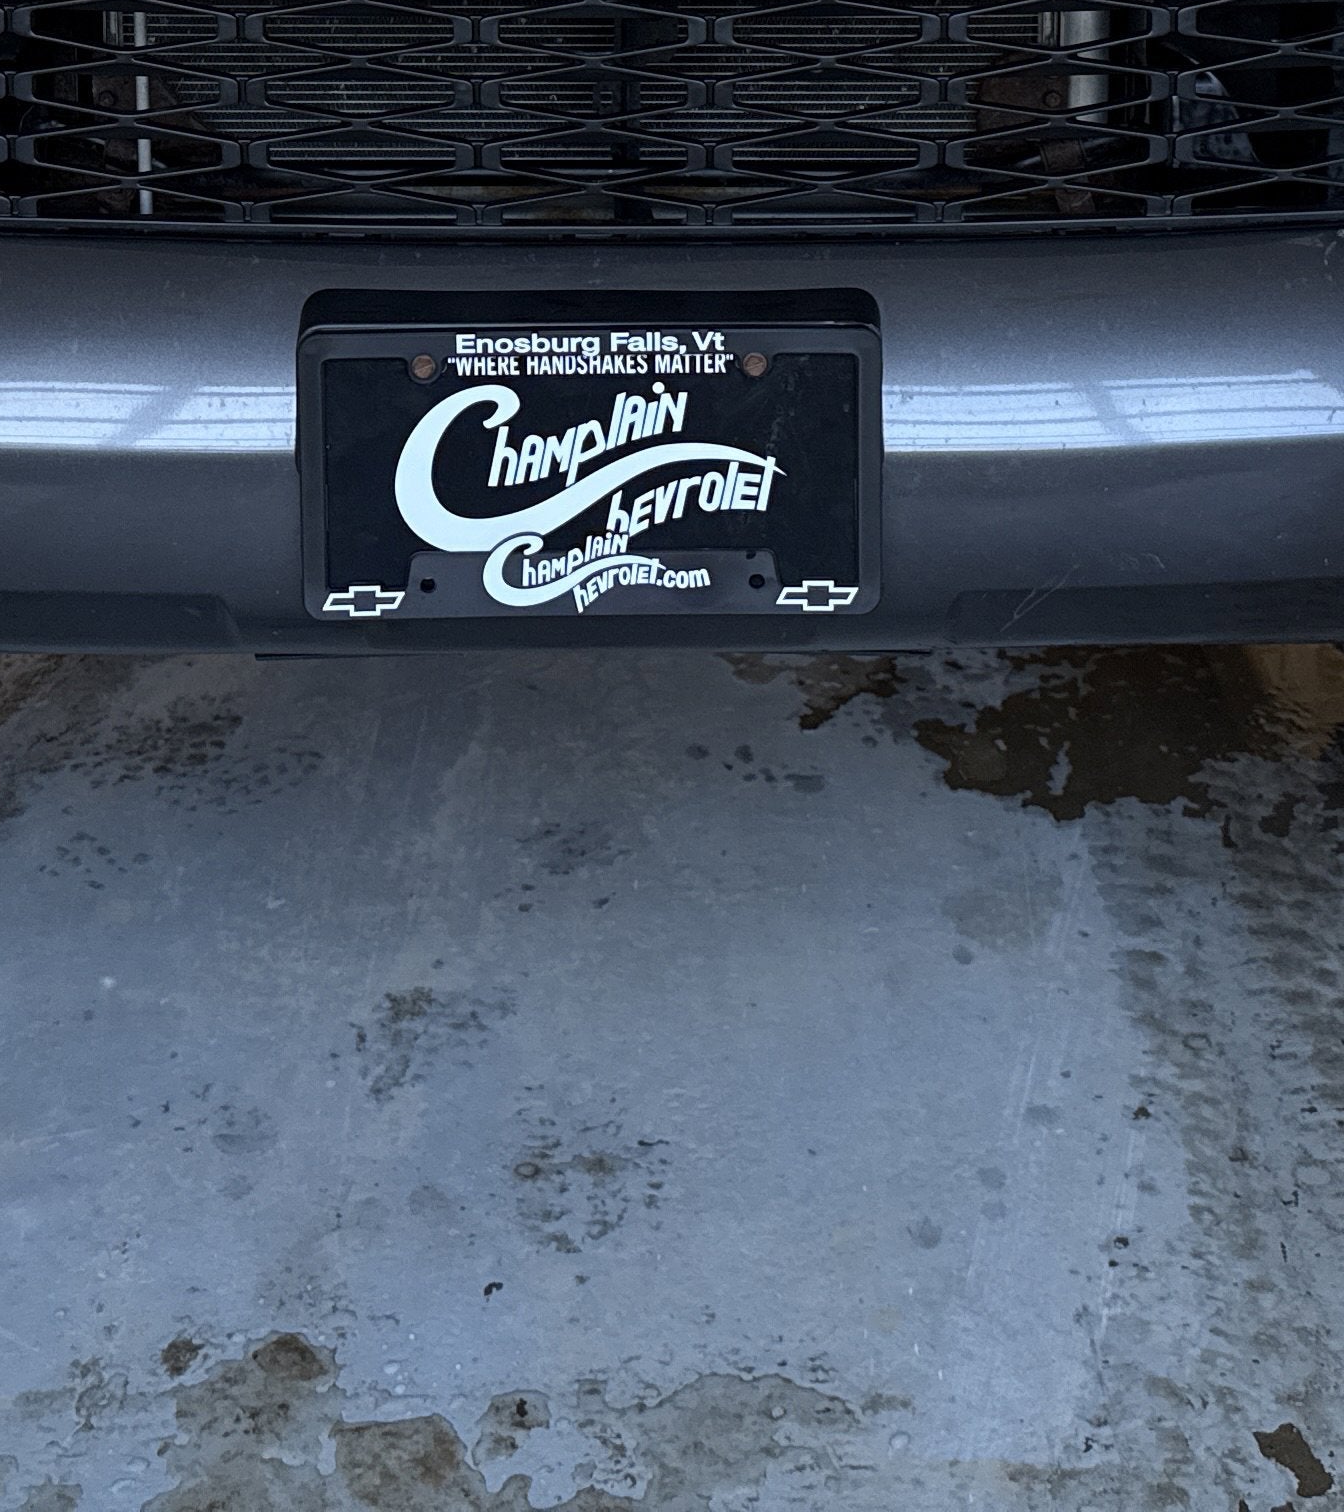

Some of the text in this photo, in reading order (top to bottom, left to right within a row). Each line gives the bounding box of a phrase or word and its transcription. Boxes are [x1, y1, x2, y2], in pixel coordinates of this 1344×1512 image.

[455, 331, 725, 357] Enosburg Falls, Vt
[447, 353, 734, 376] "WHERE HANDSHAKES MATTER"
